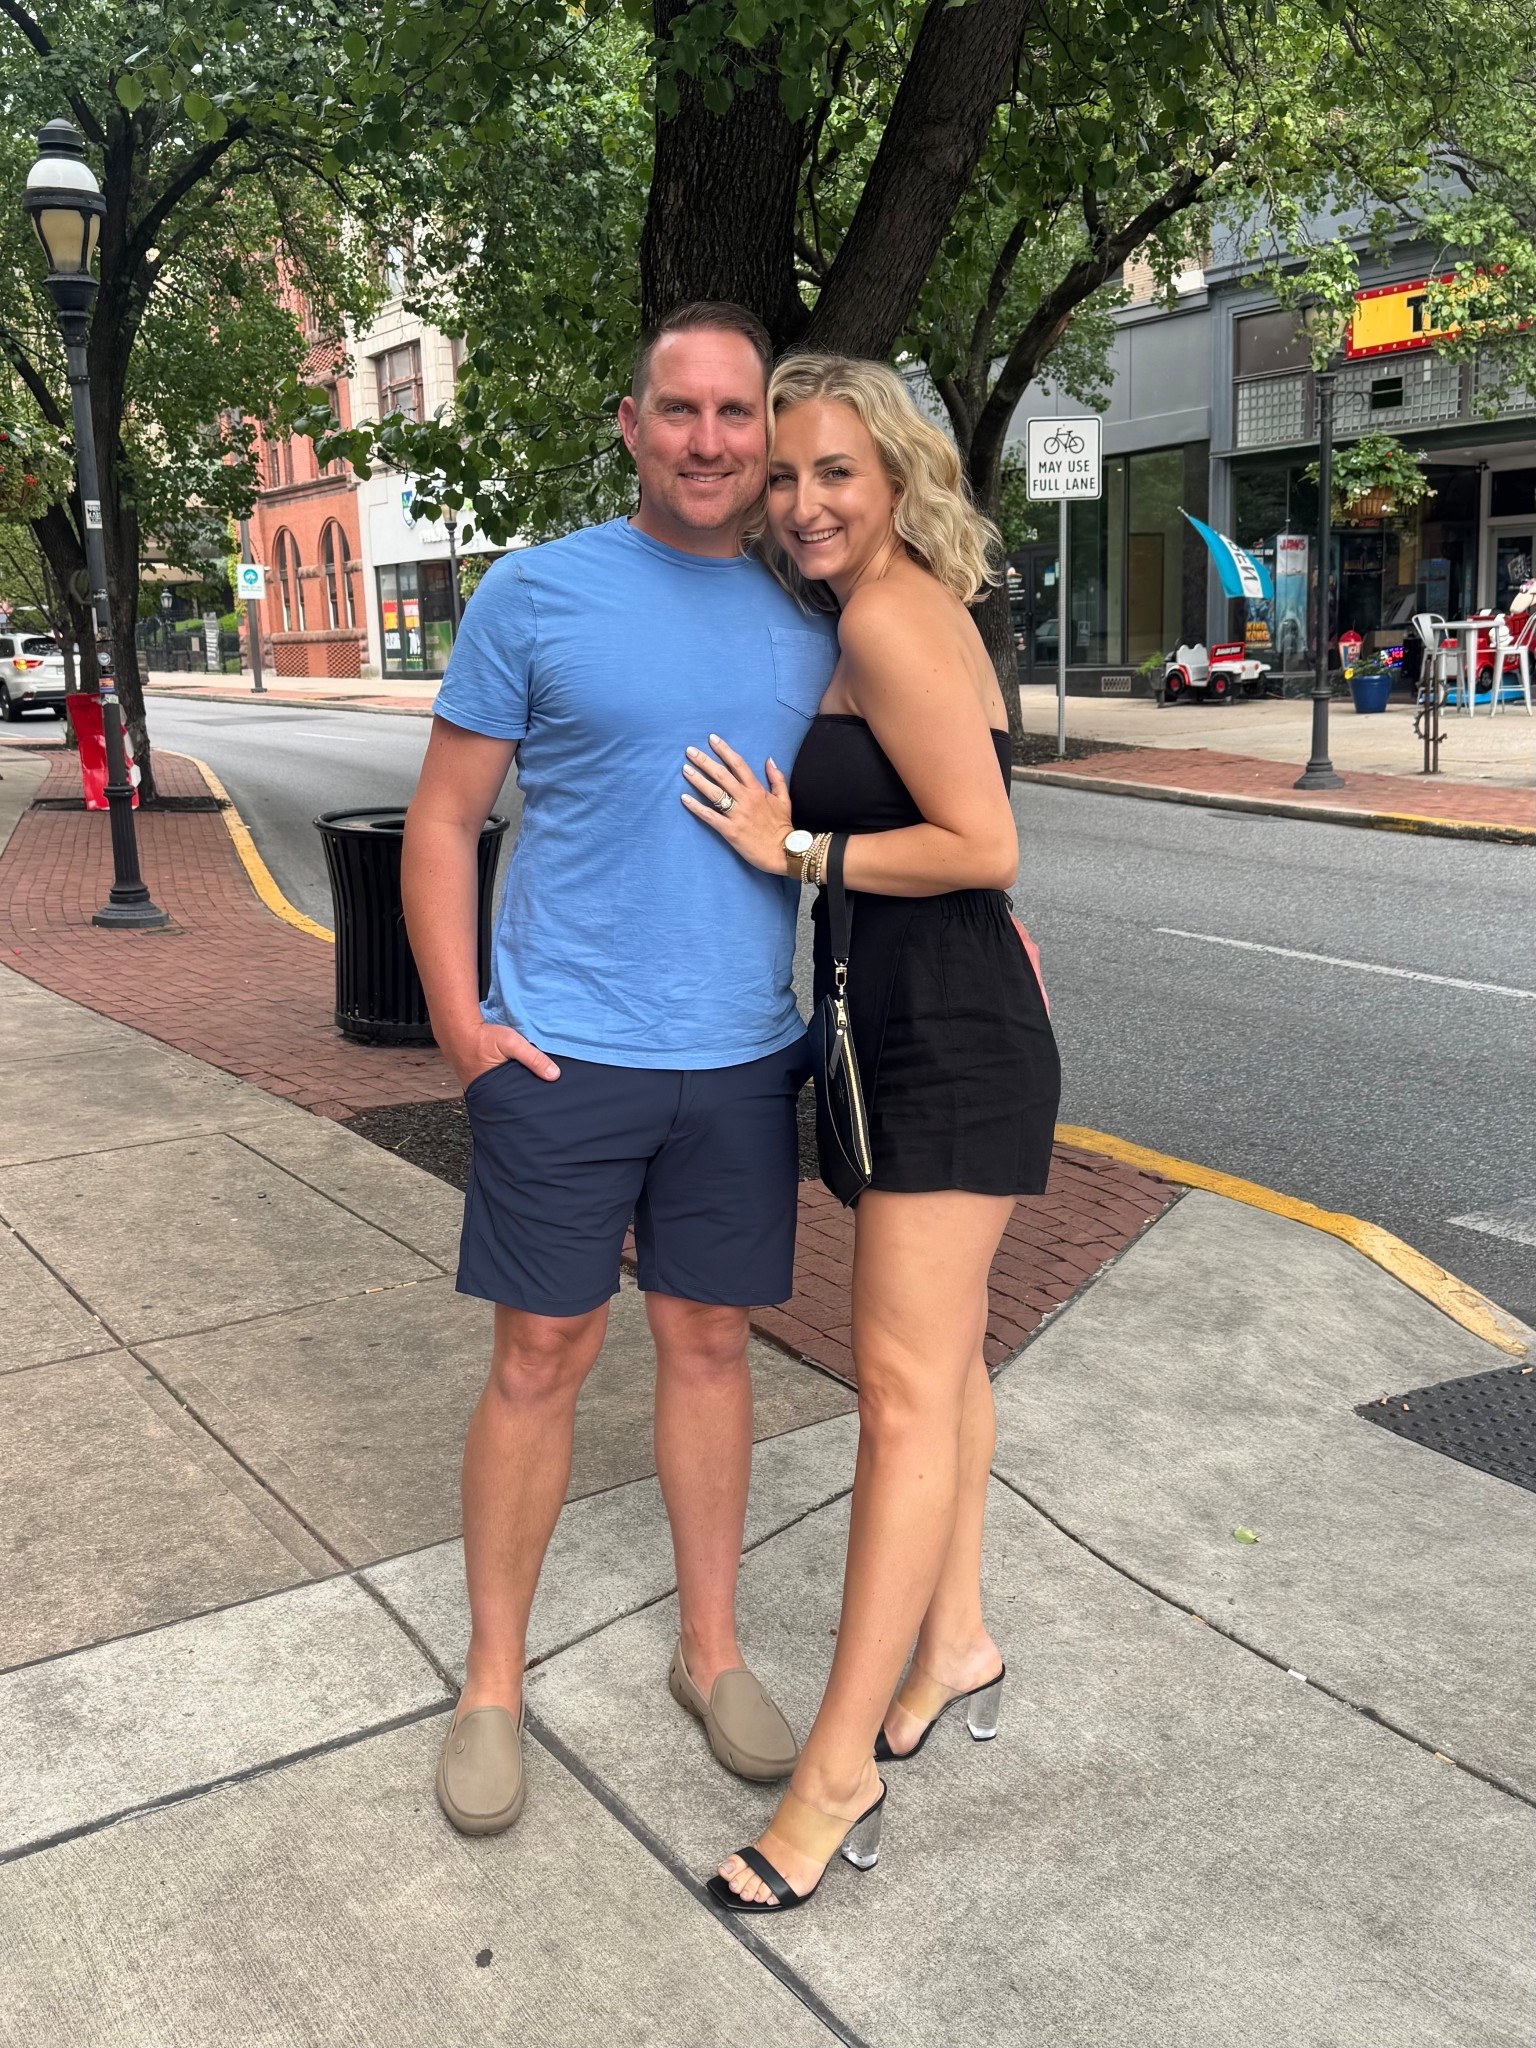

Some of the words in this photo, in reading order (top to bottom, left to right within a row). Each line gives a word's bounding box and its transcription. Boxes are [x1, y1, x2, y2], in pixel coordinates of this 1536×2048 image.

[1038, 461, 1063, 474] MAY
[1068, 459, 1090, 473] USE
[1033, 478, 1060, 492] FULL
[1065, 477, 1096, 491] LANE
[1279, 538, 1306, 551] JAWS
[1245, 630, 1271, 642] KONG
